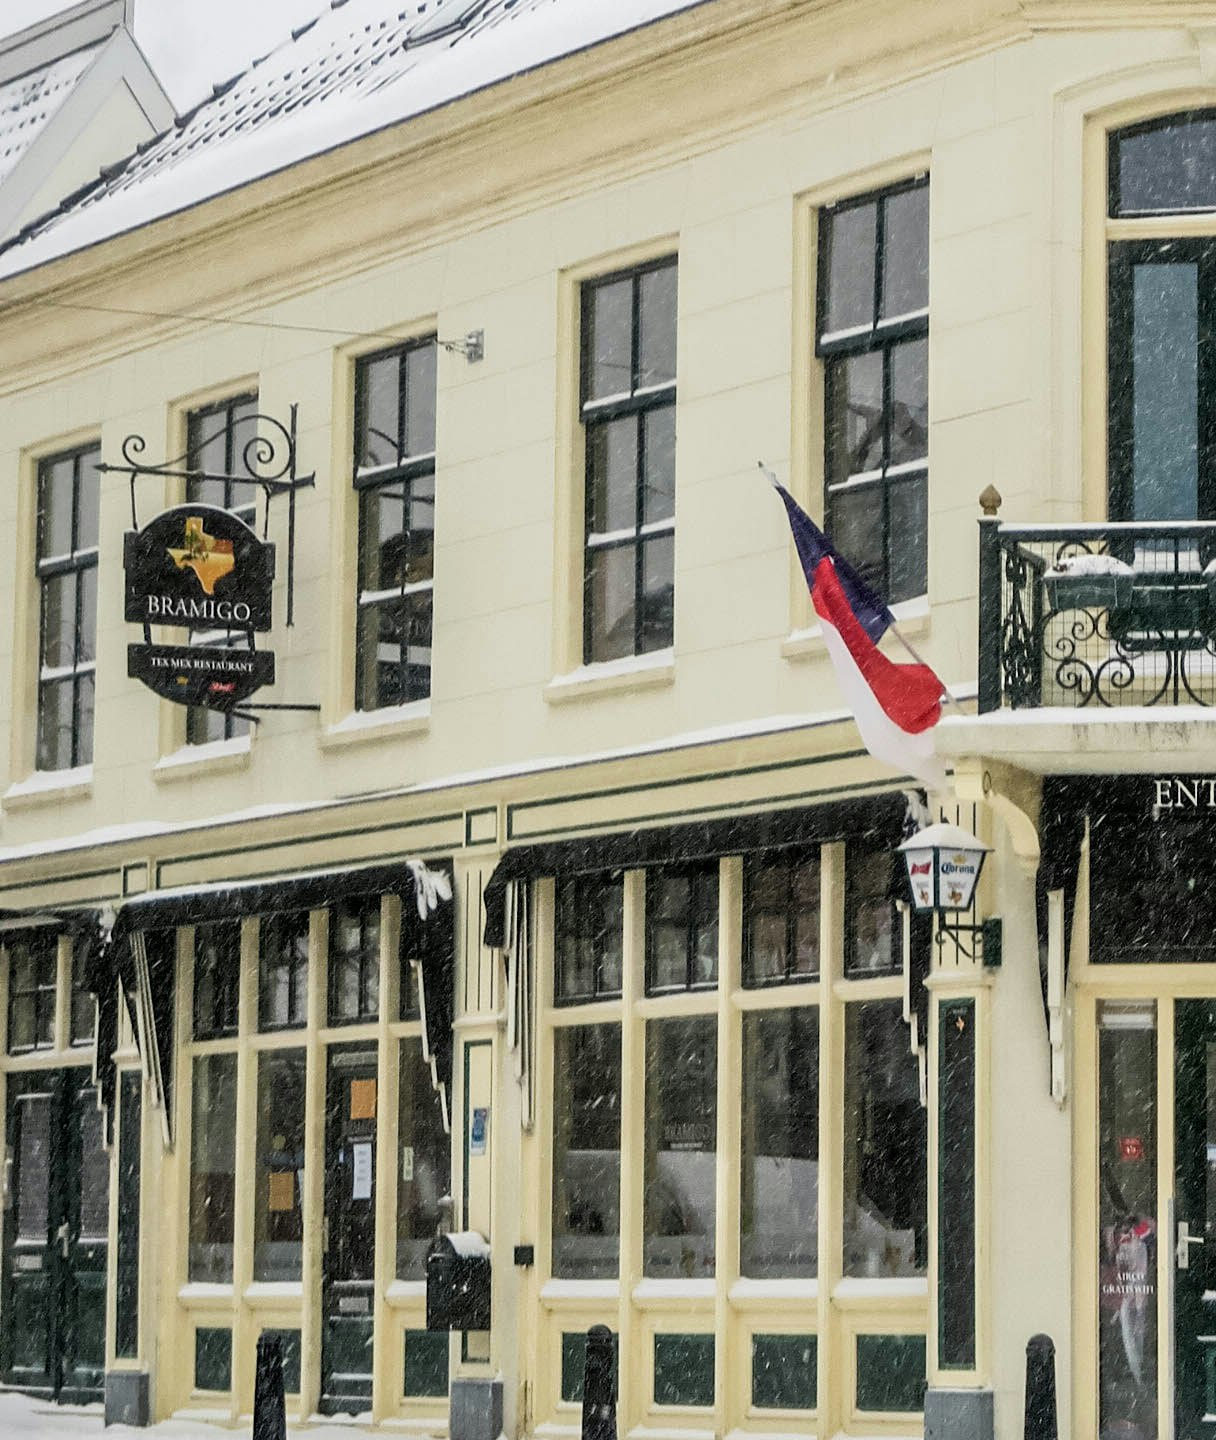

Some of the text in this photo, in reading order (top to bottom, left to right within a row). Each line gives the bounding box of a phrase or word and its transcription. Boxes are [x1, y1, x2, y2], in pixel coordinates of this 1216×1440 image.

[147, 594, 252, 622] BRAMIGO
[151, 657, 254, 672] TEX MEX RESTAURANT
[941, 862, 976, 875] Corona
